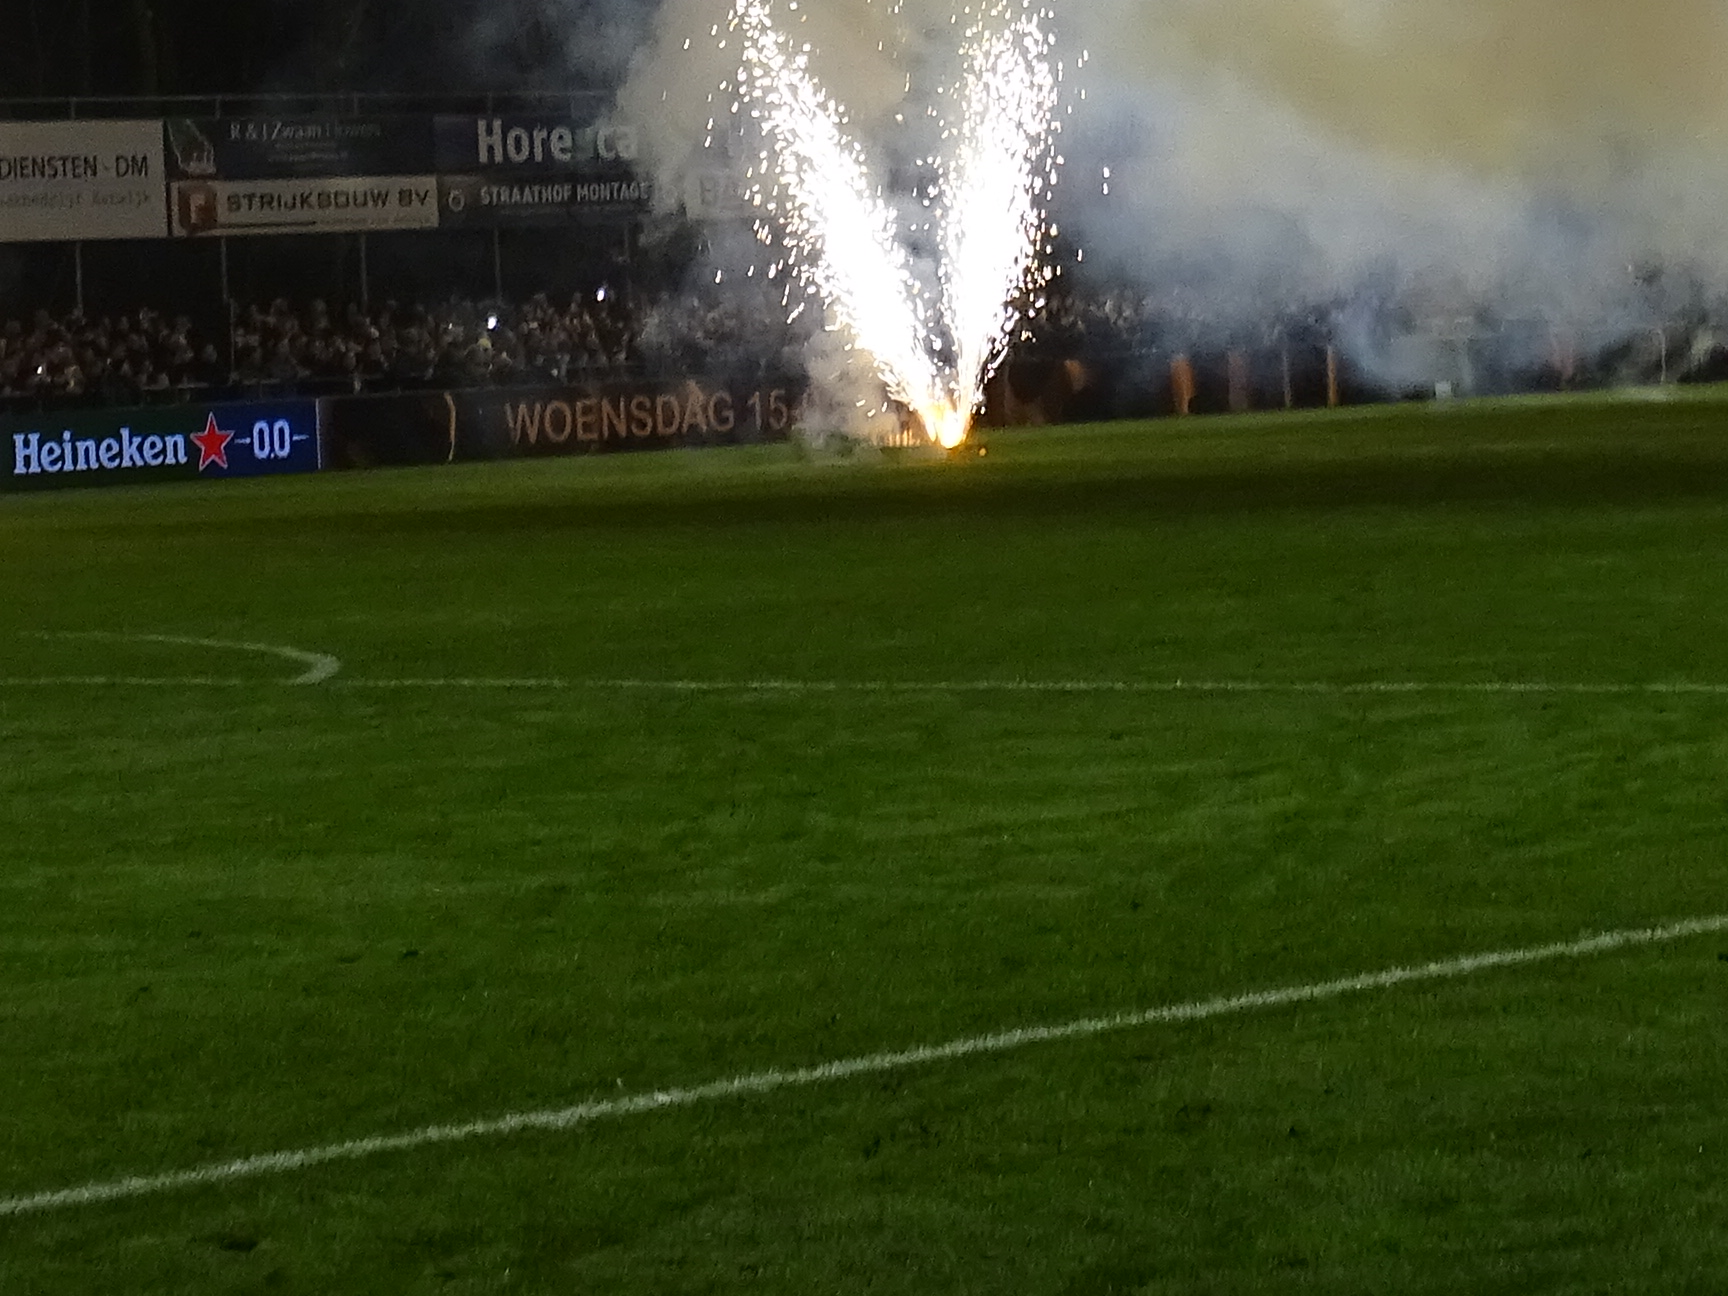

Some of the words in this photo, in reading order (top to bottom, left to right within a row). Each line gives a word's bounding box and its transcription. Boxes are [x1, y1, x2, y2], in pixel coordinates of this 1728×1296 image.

[115, 154, 149, 179] DM
[480, 183, 572, 205] STRAATHOF
[505, 392, 735, 444] WOENSDAG
[12, 426, 188, 475] Heineken
